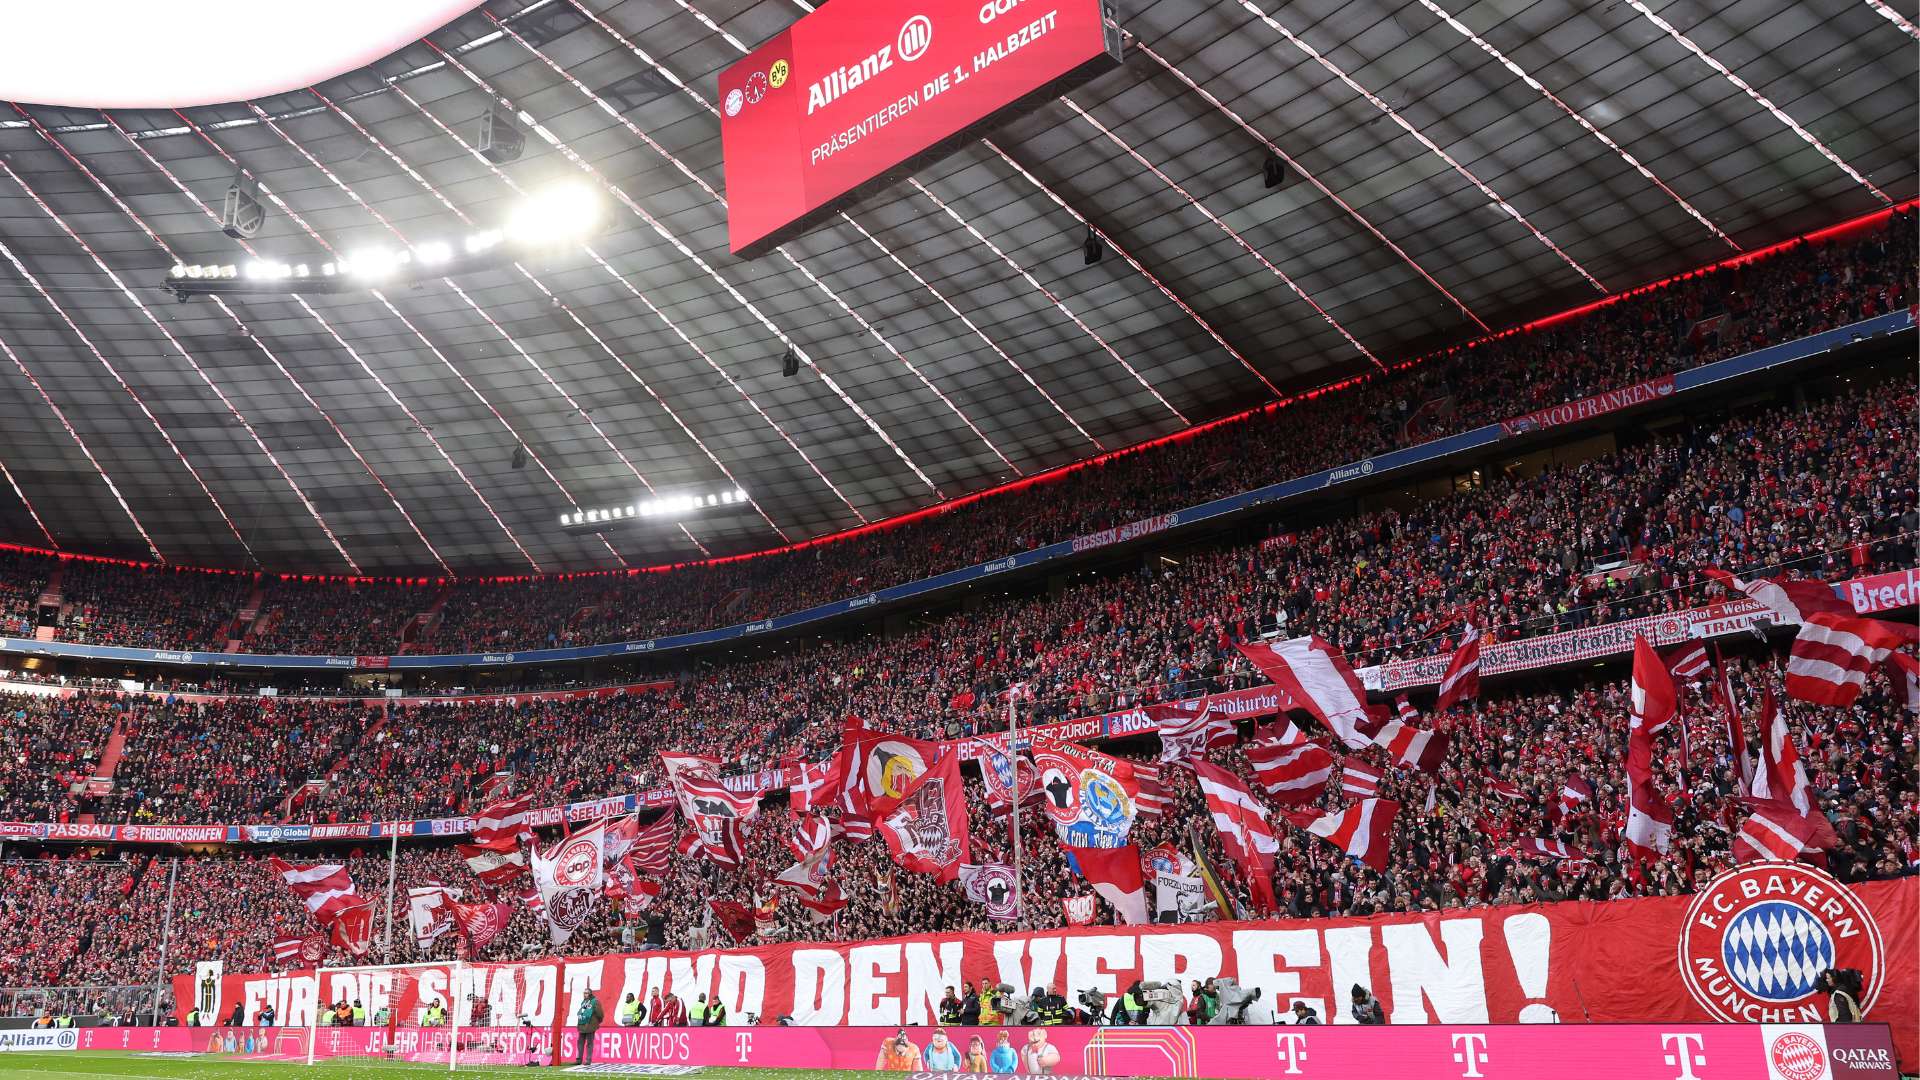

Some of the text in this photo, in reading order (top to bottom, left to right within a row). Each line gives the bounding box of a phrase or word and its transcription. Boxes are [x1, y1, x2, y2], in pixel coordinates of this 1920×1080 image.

[771, 63, 787, 82] BVB
[807, 44, 893, 115] Allianz
[811, 10, 1058, 166] PRÄSENTIEREN DIE 1. HALBZEIT
[1577, 381, 1658, 419] FRANKEN
[1329, 466, 1360, 482] Allianz
[1072, 514, 1170, 552] GIESSEN BULLS
[984, 560, 1006, 573] Allianz
[849, 597, 868, 608] Allianz
[1690, 608, 1712, 622] Rot
[745, 622, 765, 633] Allianz
[625, 643, 647, 651] Allianz
[155, 652, 181, 661] Allianz
[326, 658, 349, 666] Allianz
[482, 654, 505, 663] Allianz
[1060, 721, 1100, 740] ZÜRICH
[571, 801, 625, 821] SEELAND
[48, 824, 113, 837] PASSAU
[140, 827, 223, 841] FRIEDRICHSHAFEN
[283, 828, 310, 838] Global
[399, 824, 413, 834] 94
[1740, 875, 1860, 939] BAYERN
[244, 972, 315, 1026] FÜR
[331, 971, 392, 1026] DIE
[417, 959, 604, 1026] STADT
[615, 953, 765, 1026] UND
[792, 942, 964, 1026] DEN
[1696, 958, 1822, 1023] MÜNCHEN
[0, 1034, 54, 1046] Allianz
[365, 1032, 380, 1052] JE
[625, 1032, 690, 1060] WIRD'S
[1784, 1034, 1820, 1055] BAYERN
[1833, 1048, 1890, 1064] QATAR
[1778, 1063, 1822, 1080] MÜNCHEN
[1849, 1062, 1892, 1070] AIRWAYS
